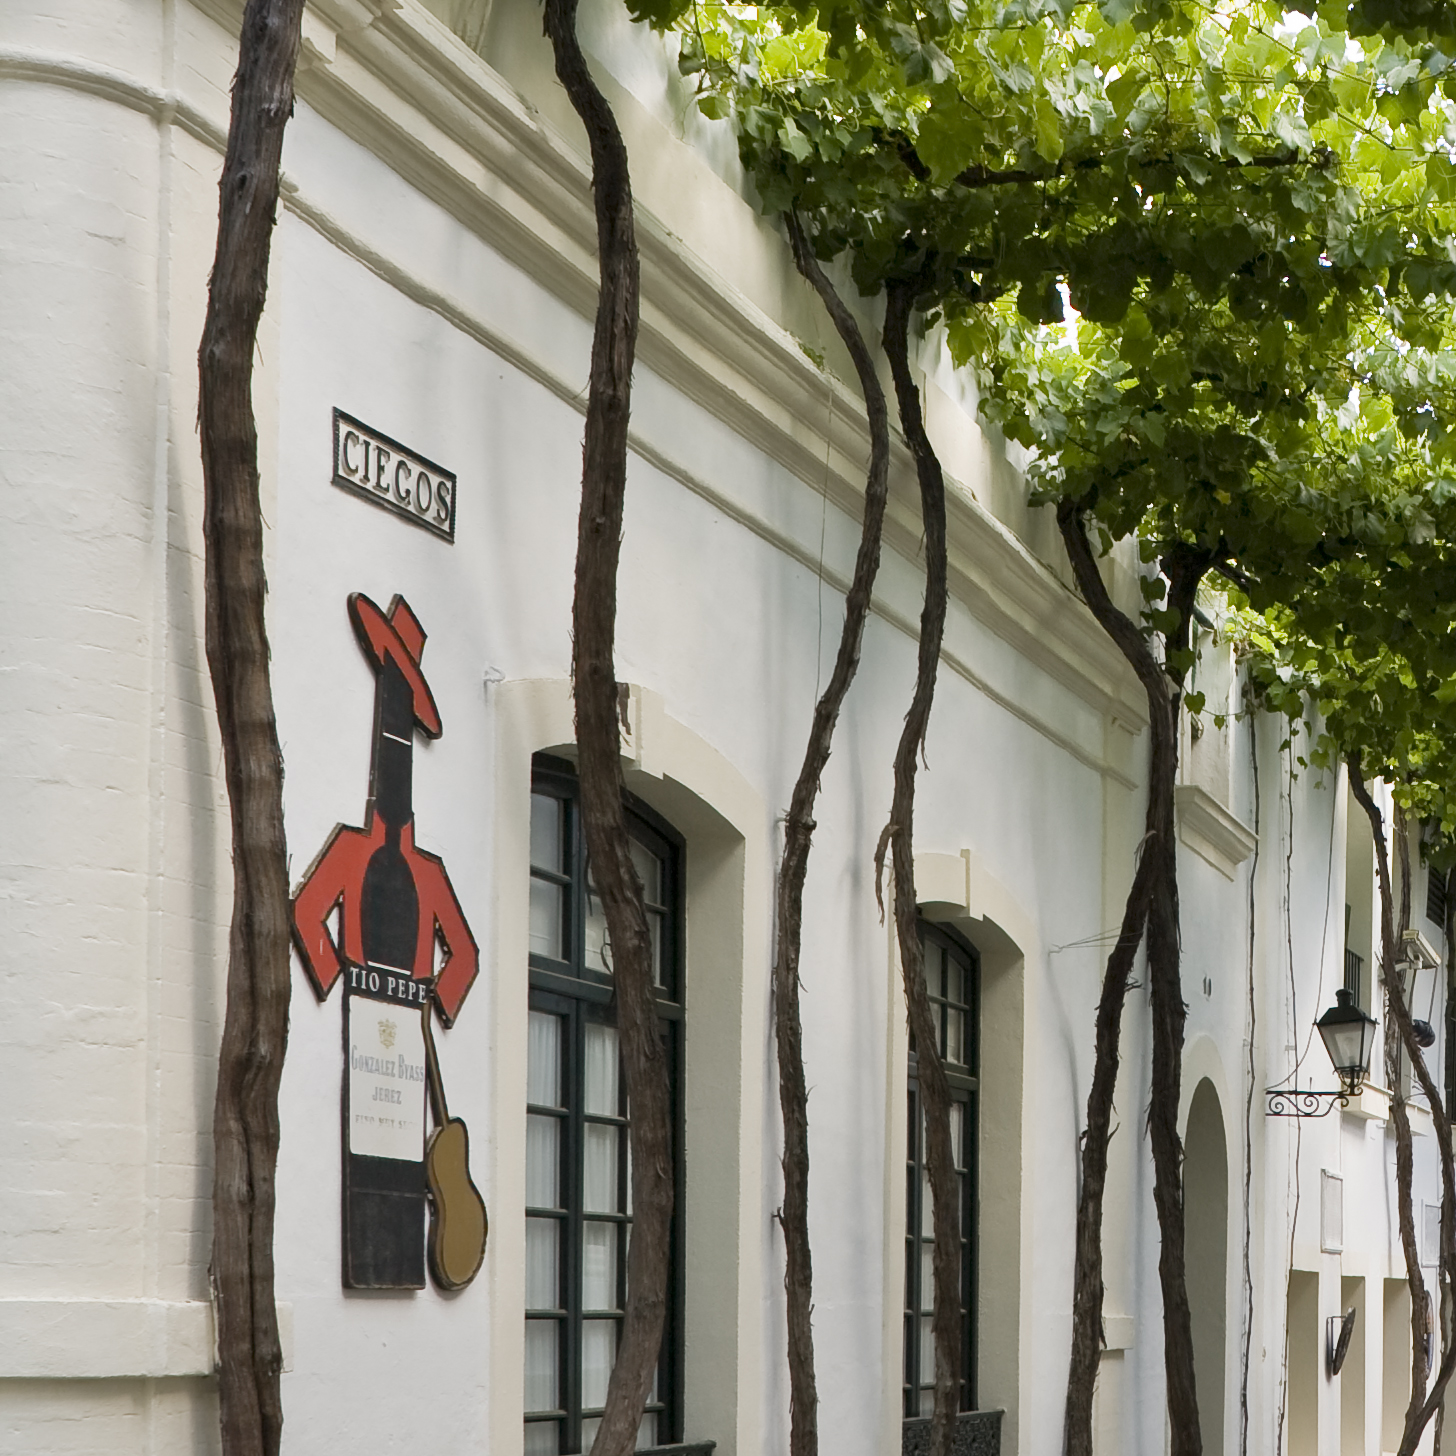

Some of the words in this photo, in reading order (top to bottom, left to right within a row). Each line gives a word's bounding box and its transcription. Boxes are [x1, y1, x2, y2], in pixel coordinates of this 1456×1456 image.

[343, 430, 450, 523] CIEGOS
[349, 966, 380, 992] TIO
[387, 976, 427, 1003] PEPE
[351, 1044, 396, 1078] GONZALEZ
[398, 1054, 424, 1083] BYASS
[372, 1086, 402, 1105] JEREZ
